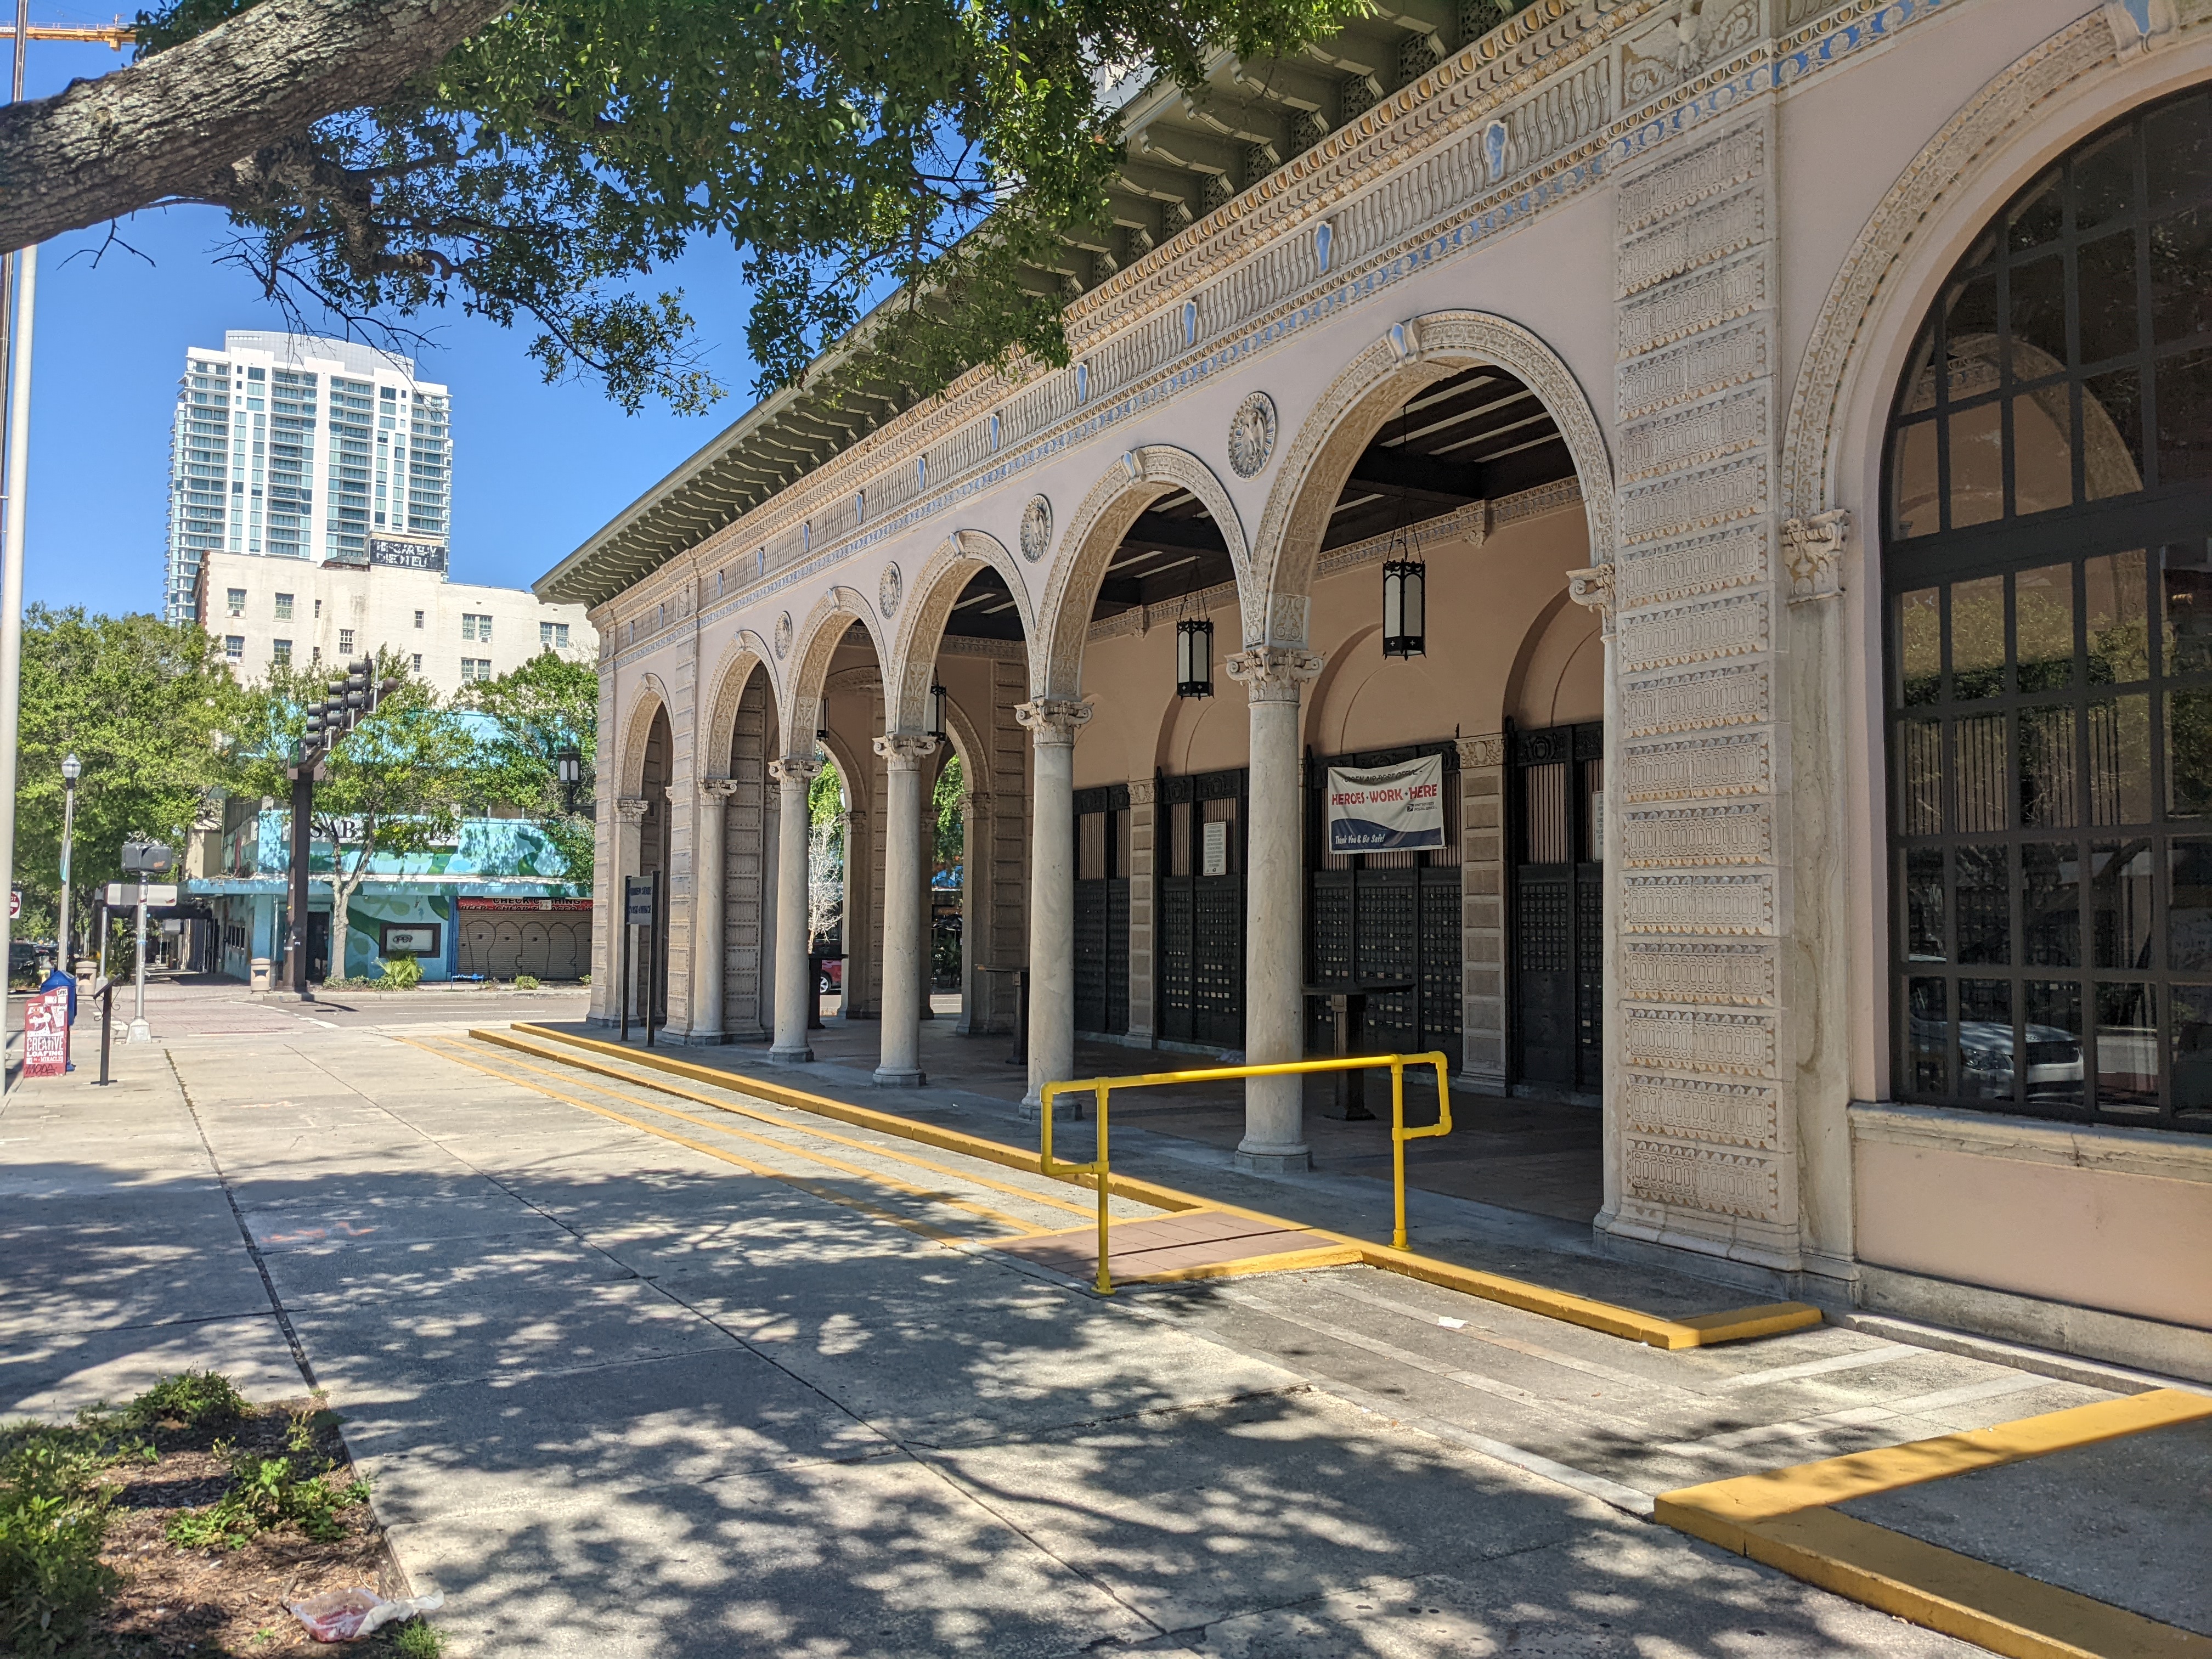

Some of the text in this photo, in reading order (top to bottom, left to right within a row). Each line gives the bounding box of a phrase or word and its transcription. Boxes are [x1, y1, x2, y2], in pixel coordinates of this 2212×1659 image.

[1377, 773, 1396, 781] POST
[1395, 768, 1418, 779] OFFICE
[1331, 783, 1437, 805] HEROES WORK HERE
[1335, 835, 1347, 844] Thank
[1348, 835, 1356, 843] You
[1362, 835, 1370, 843] Be
[1371, 834, 1385, 843] Safe!
[26, 1036, 64, 1051] CREATIVE
